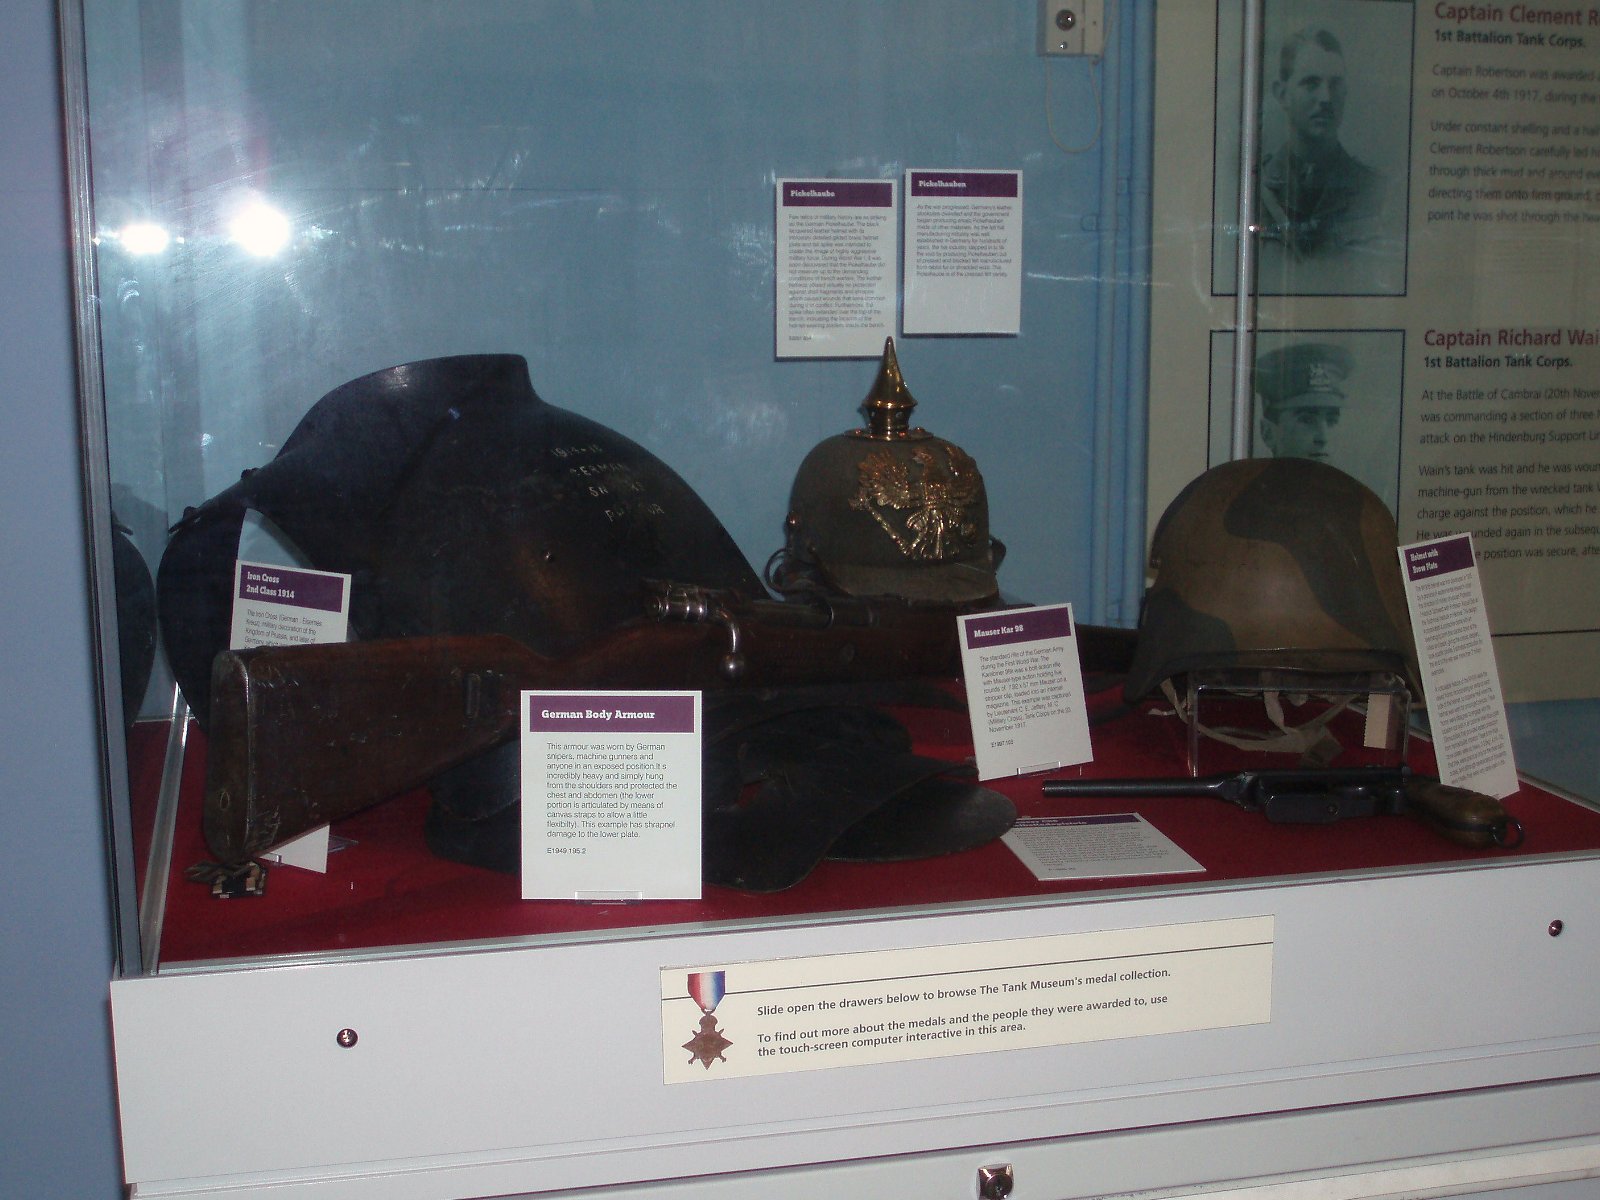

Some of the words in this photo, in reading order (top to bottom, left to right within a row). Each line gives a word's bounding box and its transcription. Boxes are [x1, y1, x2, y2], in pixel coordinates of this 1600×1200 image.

[1435, 3, 1504, 24] Captain
[1510, 5, 1582, 26] Clement
[1436, 29, 1453, 42] 1st
[1457, 30, 1513, 45] Battalion
[1517, 32, 1545, 46] Tank
[918, 180, 967, 188] Pickelhauben
[790, 189, 836, 197] Pickelhaube
[1424, 329, 1492, 350] Captain
[1498, 329, 1562, 346] Richard
[1424, 356, 1441, 368] 1st
[1445, 355, 1500, 369] Battalion
[1505, 355, 1532, 368] Tank
[1536, 355, 1573, 370] Corps.
[1422, 389, 1434, 400] At
[1437, 389, 1453, 400] the
[1456, 388, 1484, 400] Battle
[1487, 388, 1498, 400] of
[1501, 389, 1541, 400] Cambrai
[1420, 412, 1440, 422] was
[1444, 410, 1507, 424] commanding
[1520, 410, 1553, 421] section
[1556, 409, 1567, 420] of
[1570, 409, 1594, 420] three
[1420, 432, 1450, 444] attack
[1453, 434, 1466, 443] on
[1470, 431, 1486, 443] the
[1489, 430, 1546, 445] Hindenburg
[1548, 430, 1586, 443] Support
[1418, 464, 1451, 476] Wain's
[1454, 464, 1474, 476] tank
[1478, 466, 1498, 475] was
[1501, 463, 1513, 474] hit
[1516, 463, 1535, 474] and
[1538, 462, 1550, 473] he
[1552, 464, 1572, 473] was
[1417, 486, 1482, 499] machine-gun
[1485, 484, 1509, 496] from
[1512, 483, 1528, 495] the
[1530, 482, 1570, 494] wrecked
[1573, 482, 1594, 493] tank
[1416, 508, 1451, 521] charge
[1453, 506, 1489, 521] against
[1492, 506, 1508, 517] the
[1554, 504, 1582, 514] which
[1585, 503, 1597, 514] he
[247, 571, 261, 581] Iron
[262, 573, 280, 584] Cross
[246, 585, 259, 594] 2nd
[260, 586, 277, 596] Class
[278, 588, 295, 599] 1914
[974, 626, 1001, 638] Mauser
[1001, 626, 1014, 634] Kar
[541, 710, 584, 719] German
[585, 709, 613, 720] Body
[614, 710, 655, 719] Armour
[546, 742, 562, 750] This
[625, 743, 635, 752] by
[636, 742, 666, 751] German
[546, 753, 575, 761] snipers,
[576, 752, 607, 760] machine
[545, 763, 574, 771] anyone
[546, 771, 581, 780] incredibly
[582, 772, 604, 781] heavy
[604, 772, 620, 780] and
[620, 772, 645, 781] simply
[645, 772, 664, 781] hung
[546, 781, 564, 789] from
[564, 781, 577, 789] the
[577, 781, 613, 789] shoulders
[630, 782, 665, 790] protected
[665, 782, 678, 790] the
[546, 791, 567, 799] chest
[567, 791, 582, 799] and
[583, 791, 618, 799] abdomen
[619, 791, 634, 800] (the
[634, 791, 654, 799] lower
[546, 801, 572, 809] portion
[580, 801, 618, 809] articulated
[619, 801, 629, 810] by
[656, 801, 664, 809] of
[546, 811, 573, 819] canvas
[573, 811, 597, 820] straps
[597, 811, 606, 819] to
[606, 811, 626, 819] allow
[632, 811, 648, 819] little
[580, 820, 596, 828] This
[597, 821, 628, 829] example
[644, 821, 675, 829] shrapnel
[546, 830, 577, 839] damage
[578, 830, 586, 838] to
[586, 830, 599, 838] the
[599, 830, 619, 838] lower
[620, 830, 641, 839] plate.
[757, 1005, 784, 1016] Slide
[786, 1004, 815, 1014] open
[817, 1000, 836, 1010] the
[839, 997, 883, 1008] drawers
[886, 993, 920, 1003] below
[922, 992, 935, 1000] to
[937, 988, 977, 999] browse
[979, 985, 999, 994] The
[1001, 981, 1027, 992] Tank
[1030, 977, 1083, 989] Museum's
[1085, 973, 1117, 984] medal
[1119, 969, 1171, 981] collection.
[756, 1033, 771, 1043] To
[774, 1030, 796, 1041] find
[799, 1029, 819, 1039] out
[821, 1027, 850, 1037] more
[852, 1023, 885, 1034] about
[887, 1020, 905, 1030] the
[908, 1016, 946, 1028] medals
[948, 1013, 969, 1024] and
[971, 1012, 989, 1022] the
[992, 1008, 1028, 1022] people
[1030, 1006, 1054, 1017] they
[1056, 1004, 1083, 1013] were
[1086, 998, 1131, 1010] awarded
[1133, 997, 1147, 1006] to,
[1150, 996, 1168, 1004] use
[757, 1047, 776, 1056] the
[778, 1041, 848, 1054] touch-screen
[851, 1035, 903, 1047] computer
[906, 1029, 962, 1041] interactive
[965, 1026, 975, 1036] in
[977, 1024, 997, 1035] this
[1000, 1023, 1026, 1032] area.
